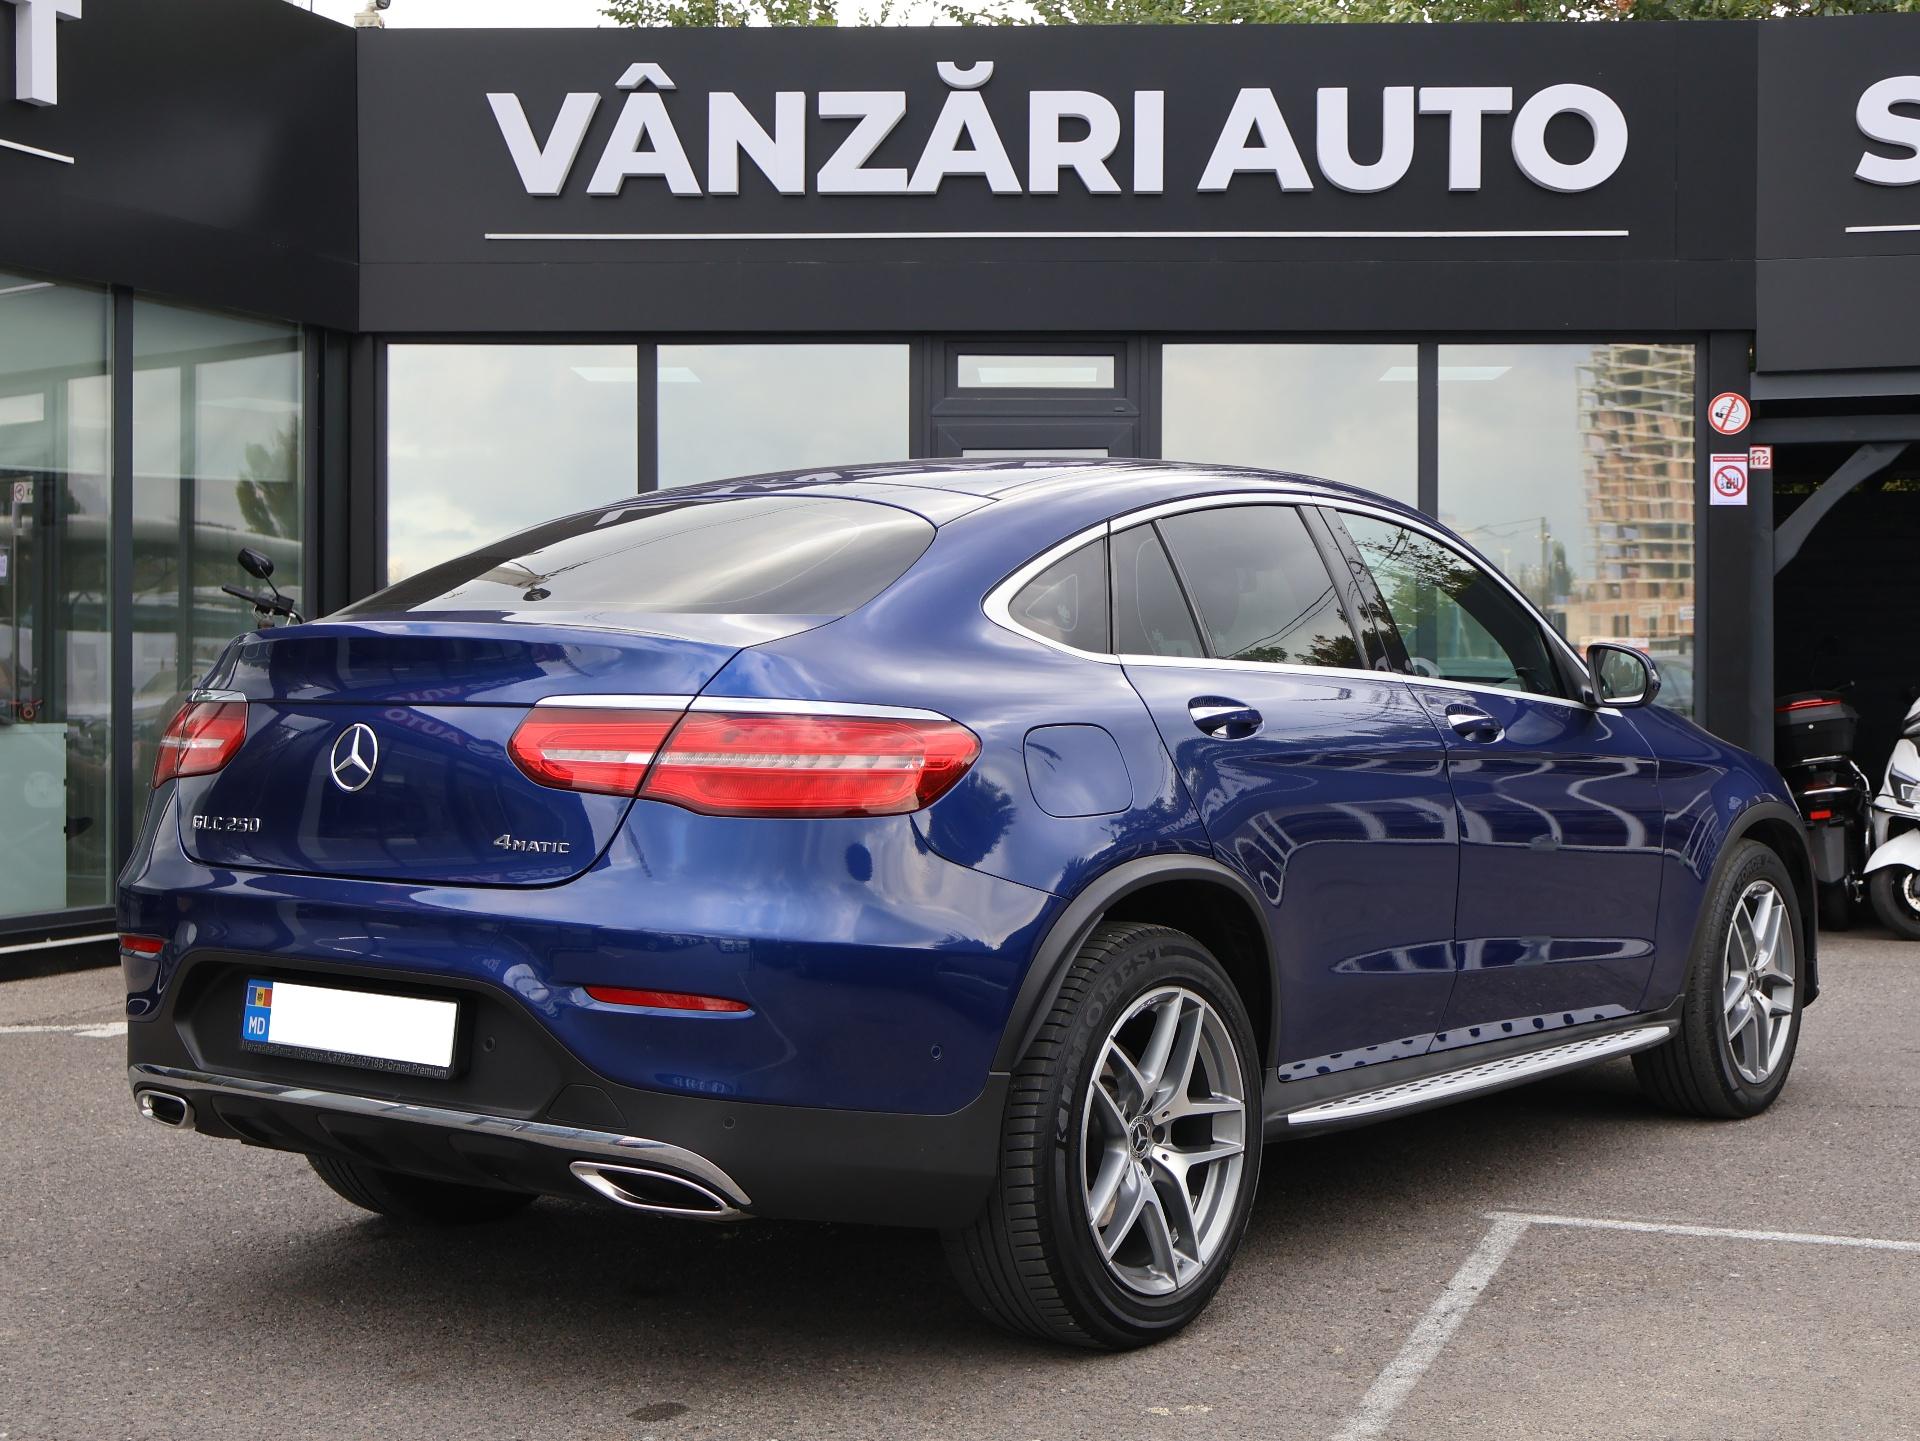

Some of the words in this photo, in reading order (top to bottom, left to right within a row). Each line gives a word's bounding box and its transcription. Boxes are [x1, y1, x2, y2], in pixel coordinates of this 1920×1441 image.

[486, 61, 1165, 197] VÂNZĂRI
[1197, 83, 1629, 193] AUTO
[1750, 455, 1769, 466] 112
[193, 815, 223, 830] GLC
[226, 817, 261, 832] 250
[493, 834, 570, 853] 4MATIC
[248, 1015, 266, 1035] MD
